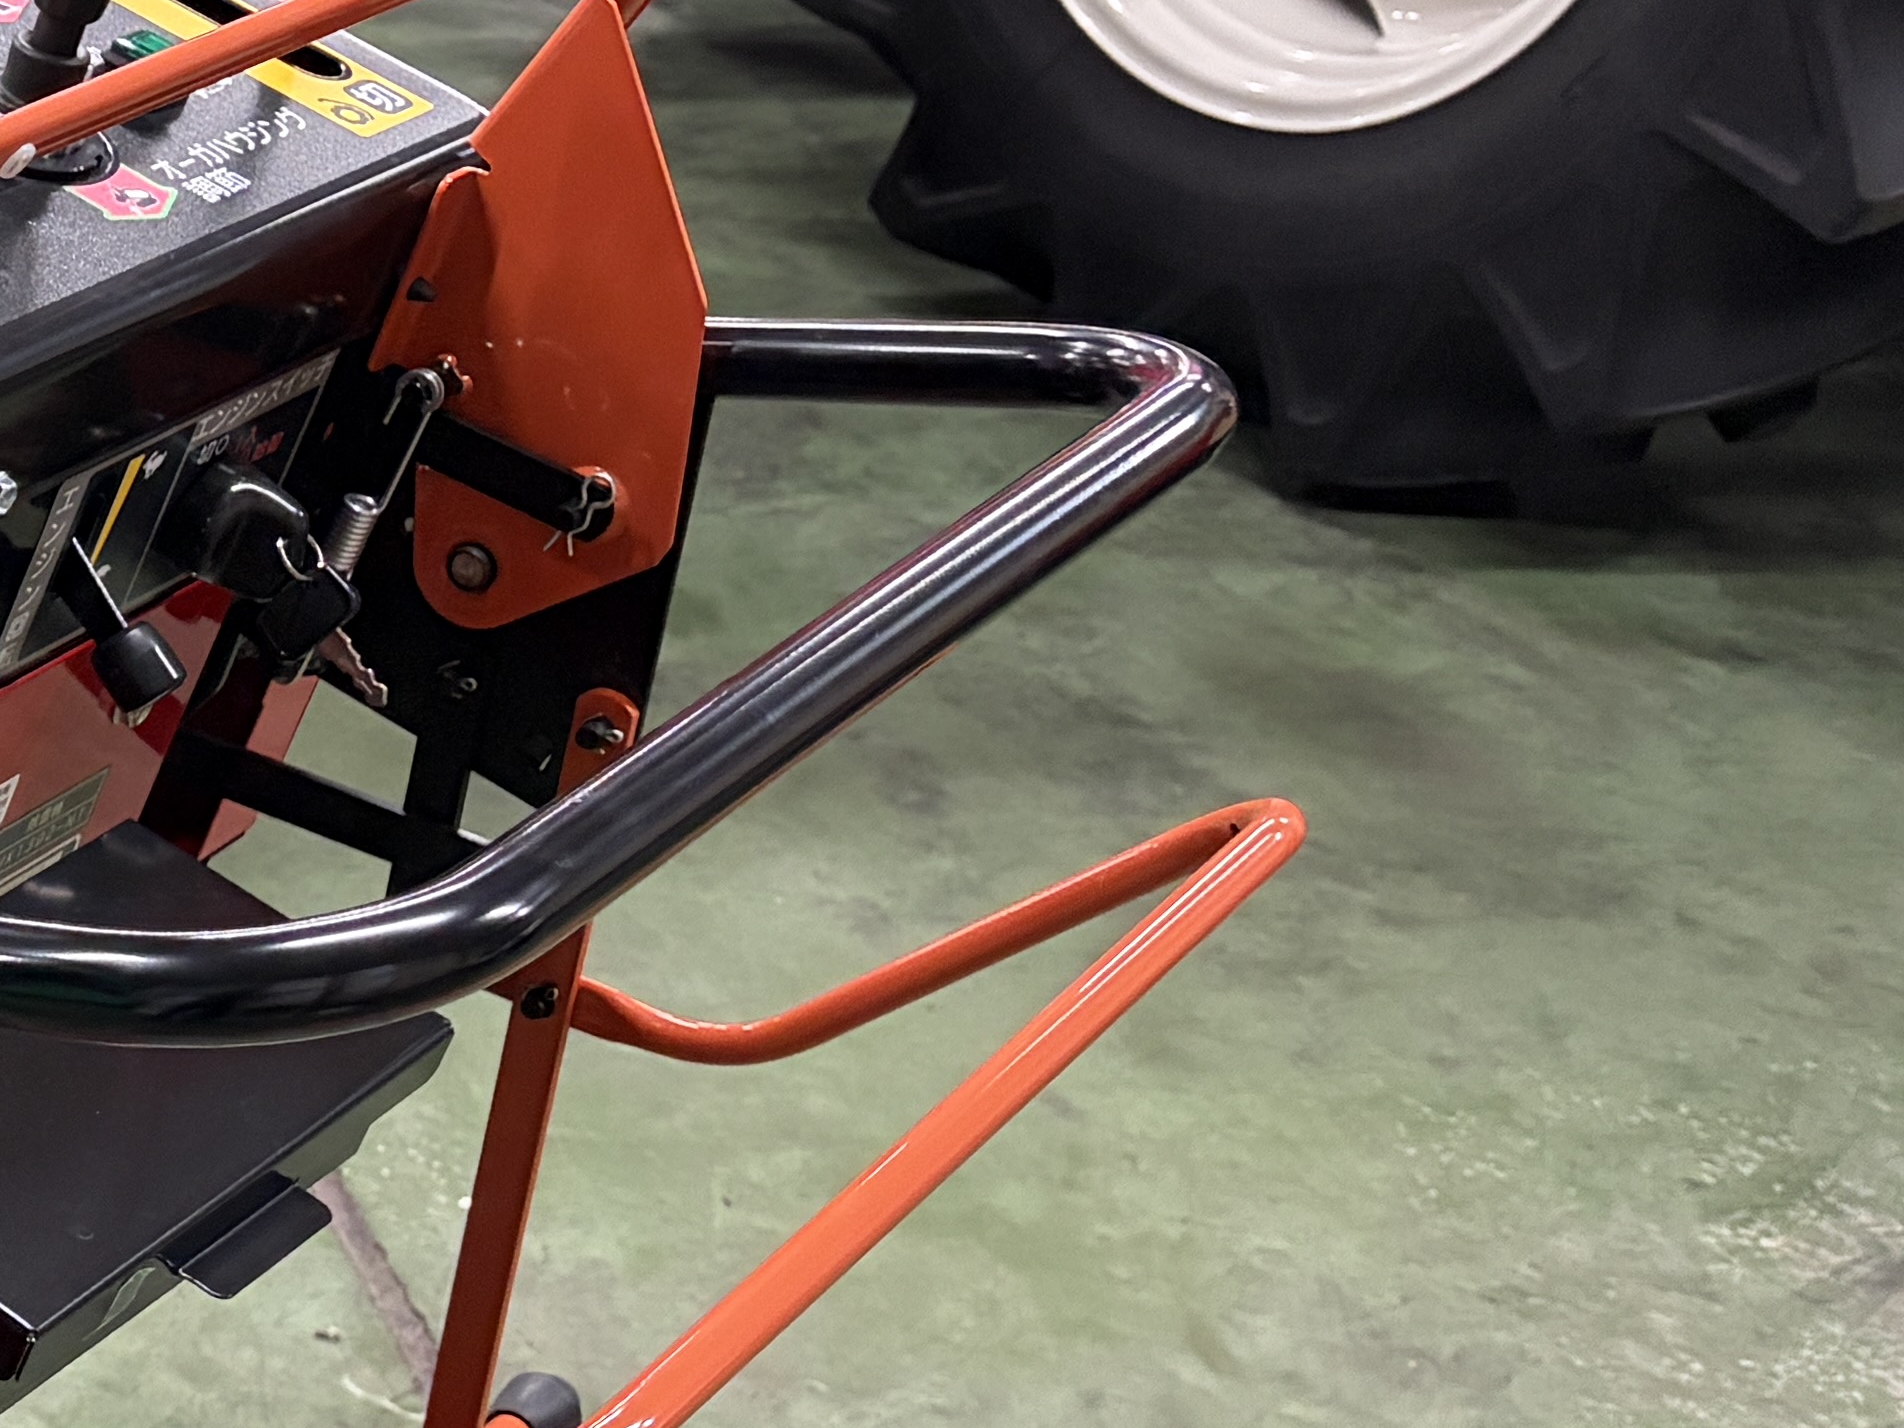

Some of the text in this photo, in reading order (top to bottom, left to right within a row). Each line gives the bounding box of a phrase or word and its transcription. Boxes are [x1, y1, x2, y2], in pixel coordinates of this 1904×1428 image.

[349, 81, 406, 112] 切
[151, 106, 307, 181] オーガハウジング
[182, 166, 252, 204] 調節
